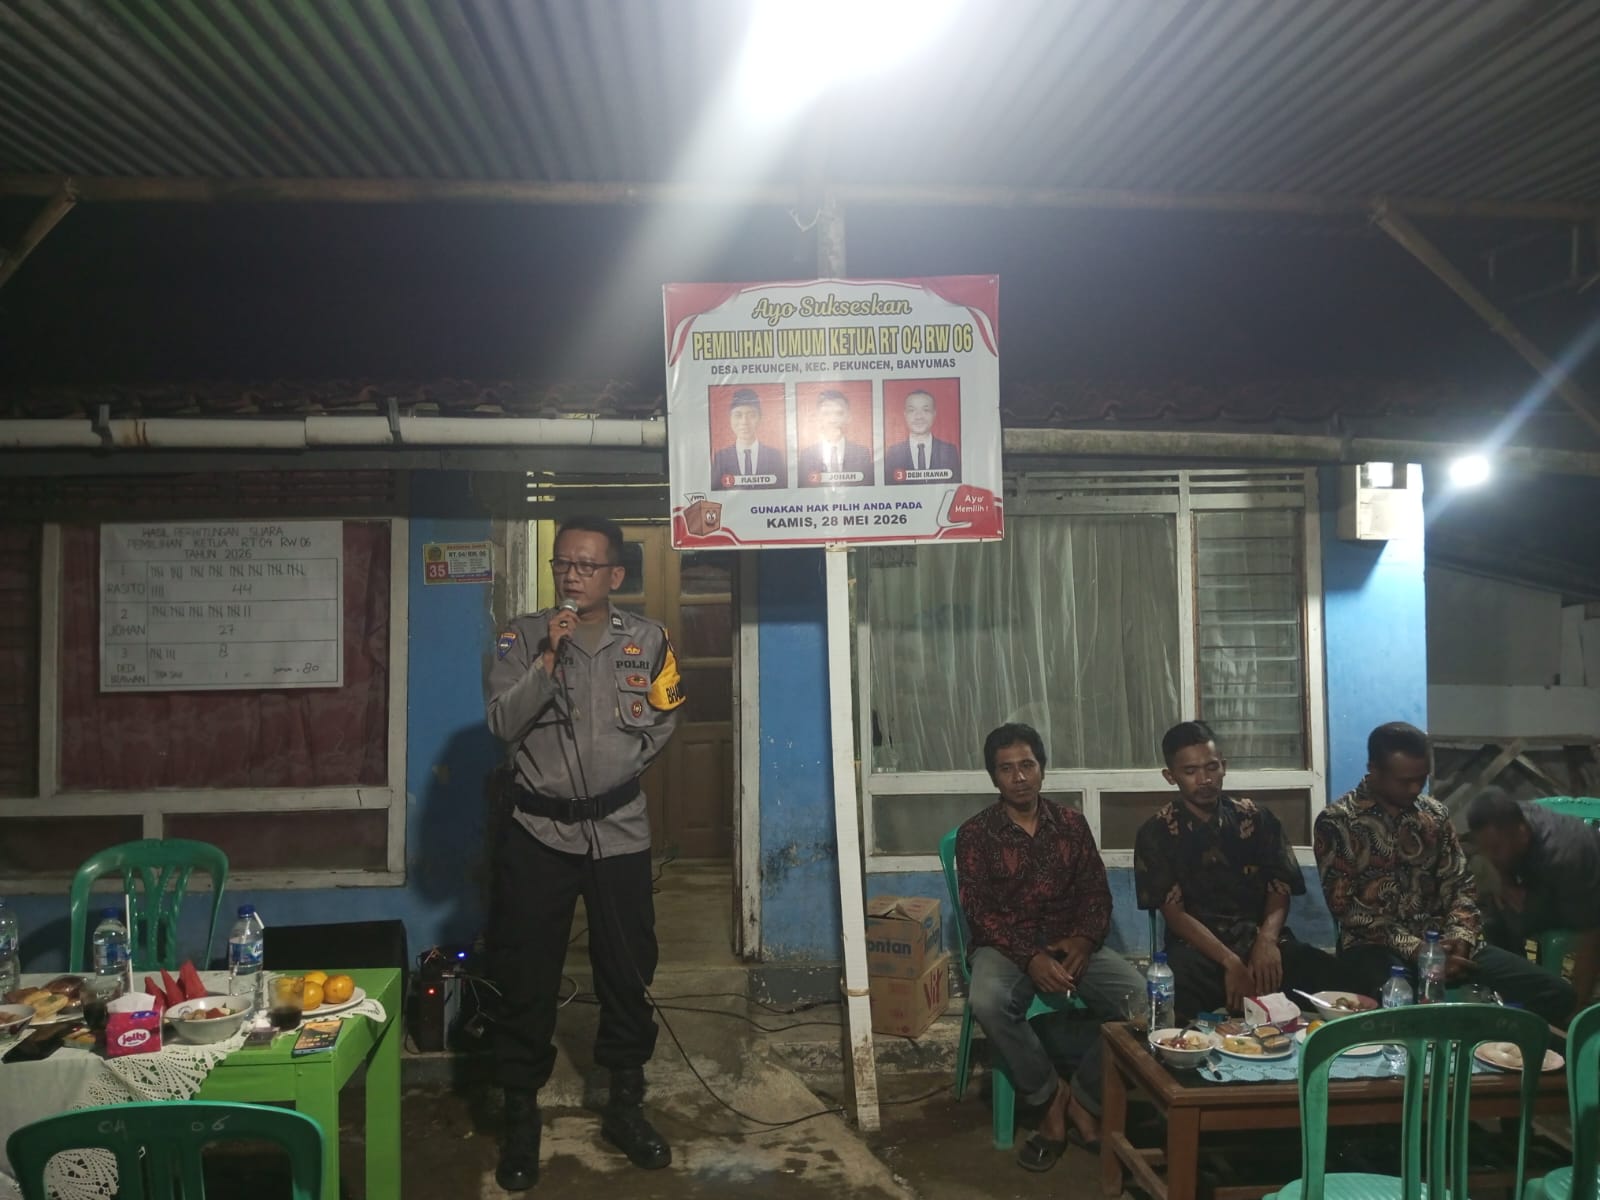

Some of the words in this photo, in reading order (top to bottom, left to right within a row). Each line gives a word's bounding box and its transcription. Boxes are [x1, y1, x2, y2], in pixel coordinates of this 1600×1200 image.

[752, 298, 797, 326] Ayo
[799, 293, 912, 317] Sukseskan
[692, 329, 774, 360] PEMILIHAN
[777, 327, 826, 358] UMUM
[829, 326, 877, 356] KETUA
[879, 325, 899, 354] RT
[901, 325, 922, 354] 04
[924, 324, 951, 353] RW
[953, 323, 973, 352] 06
[711, 365, 738, 375] DESA
[741, 362, 802, 374] PEKUNCEN,
[805, 362, 830, 372] KEC.
[833, 360, 894, 372] PEKUNCEN,
[897, 358, 956, 370] BANYUMAS
[897, 471, 903, 479] 3
[750, 504, 803, 514] GUNAKAN
[807, 503, 829, 513] HAK
[832, 503, 860, 511] PILIH
[863, 502, 892, 511] ANDA
[895, 501, 923, 510] PADA
[766, 516, 817, 529] KAMIS,
[822, 516, 838, 527] 28
[843, 515, 869, 526] MEI
[873, 514, 908, 525] 2026
[193, 538, 229, 548] KETUA
[241, 537, 257, 547] RT
[280, 536, 298, 547] RW
[184, 548, 217, 559] TAHUN
[225, 548, 253, 559] 2026
[429, 564, 446, 578] 35
[232, 583, 253, 596] 44
[120, 608, 128, 620] 2
[218, 624, 235, 636] 27
[615, 660, 650, 670] POLRI
[865, 940, 912, 955] ontan
